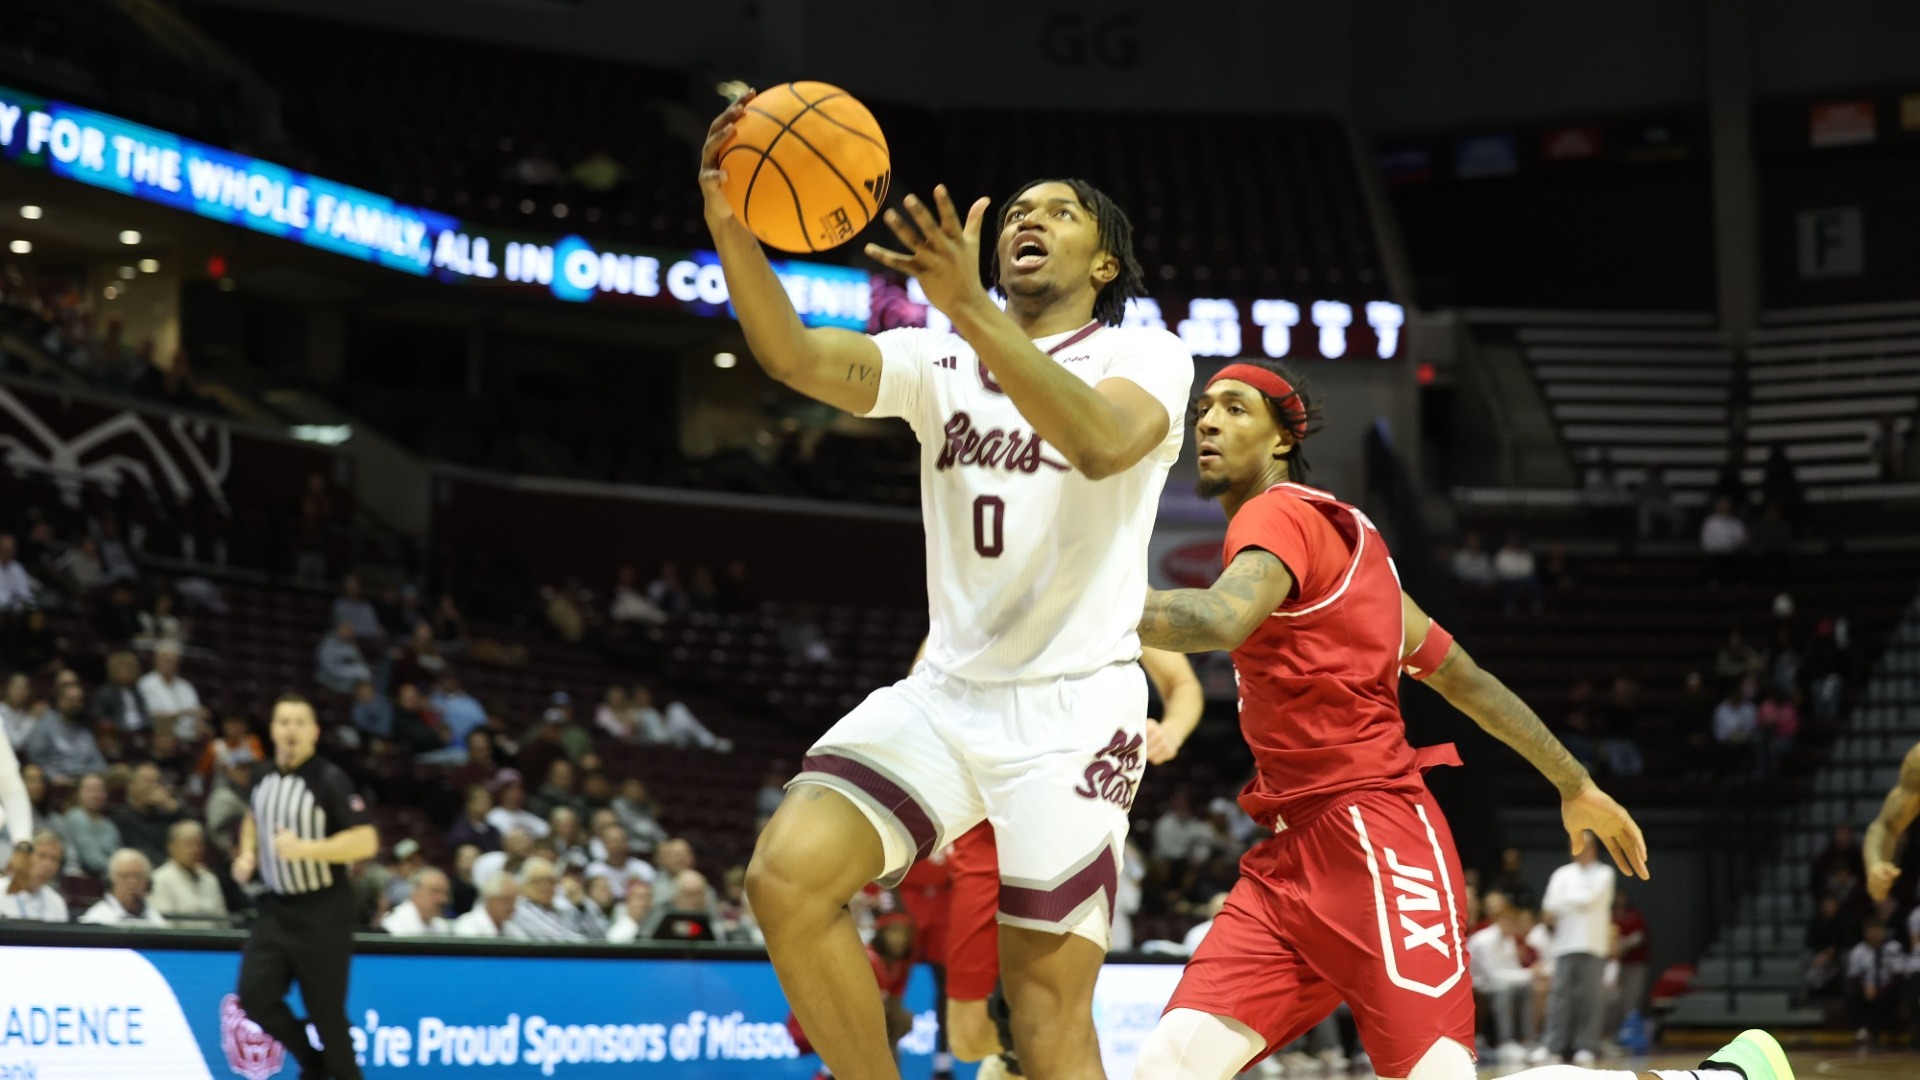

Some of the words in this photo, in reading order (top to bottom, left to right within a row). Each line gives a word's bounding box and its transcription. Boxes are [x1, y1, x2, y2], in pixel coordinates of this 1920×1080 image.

[1042, 12, 1138, 70] GG
[28, 111, 105, 171] FOR
[113, 135, 182, 191] THE
[187, 156, 309, 228] WHOLE
[314, 193, 431, 267] FAMILY,
[434, 229, 498, 278] ALL
[506, 242, 554, 284] IN
[564, 248, 659, 296] ONE
[1815, 213, 1841, 267] F
[934, 411, 1070, 474] Bears
[973, 494, 1005, 558] 0
[1383, 846, 1451, 959] JAX
[417, 1013, 520, 1066] Proud
[523, 1015, 666, 1077] Sponsors
[669, 1010, 706, 1062] of
[706, 1011, 797, 1060] Misso
